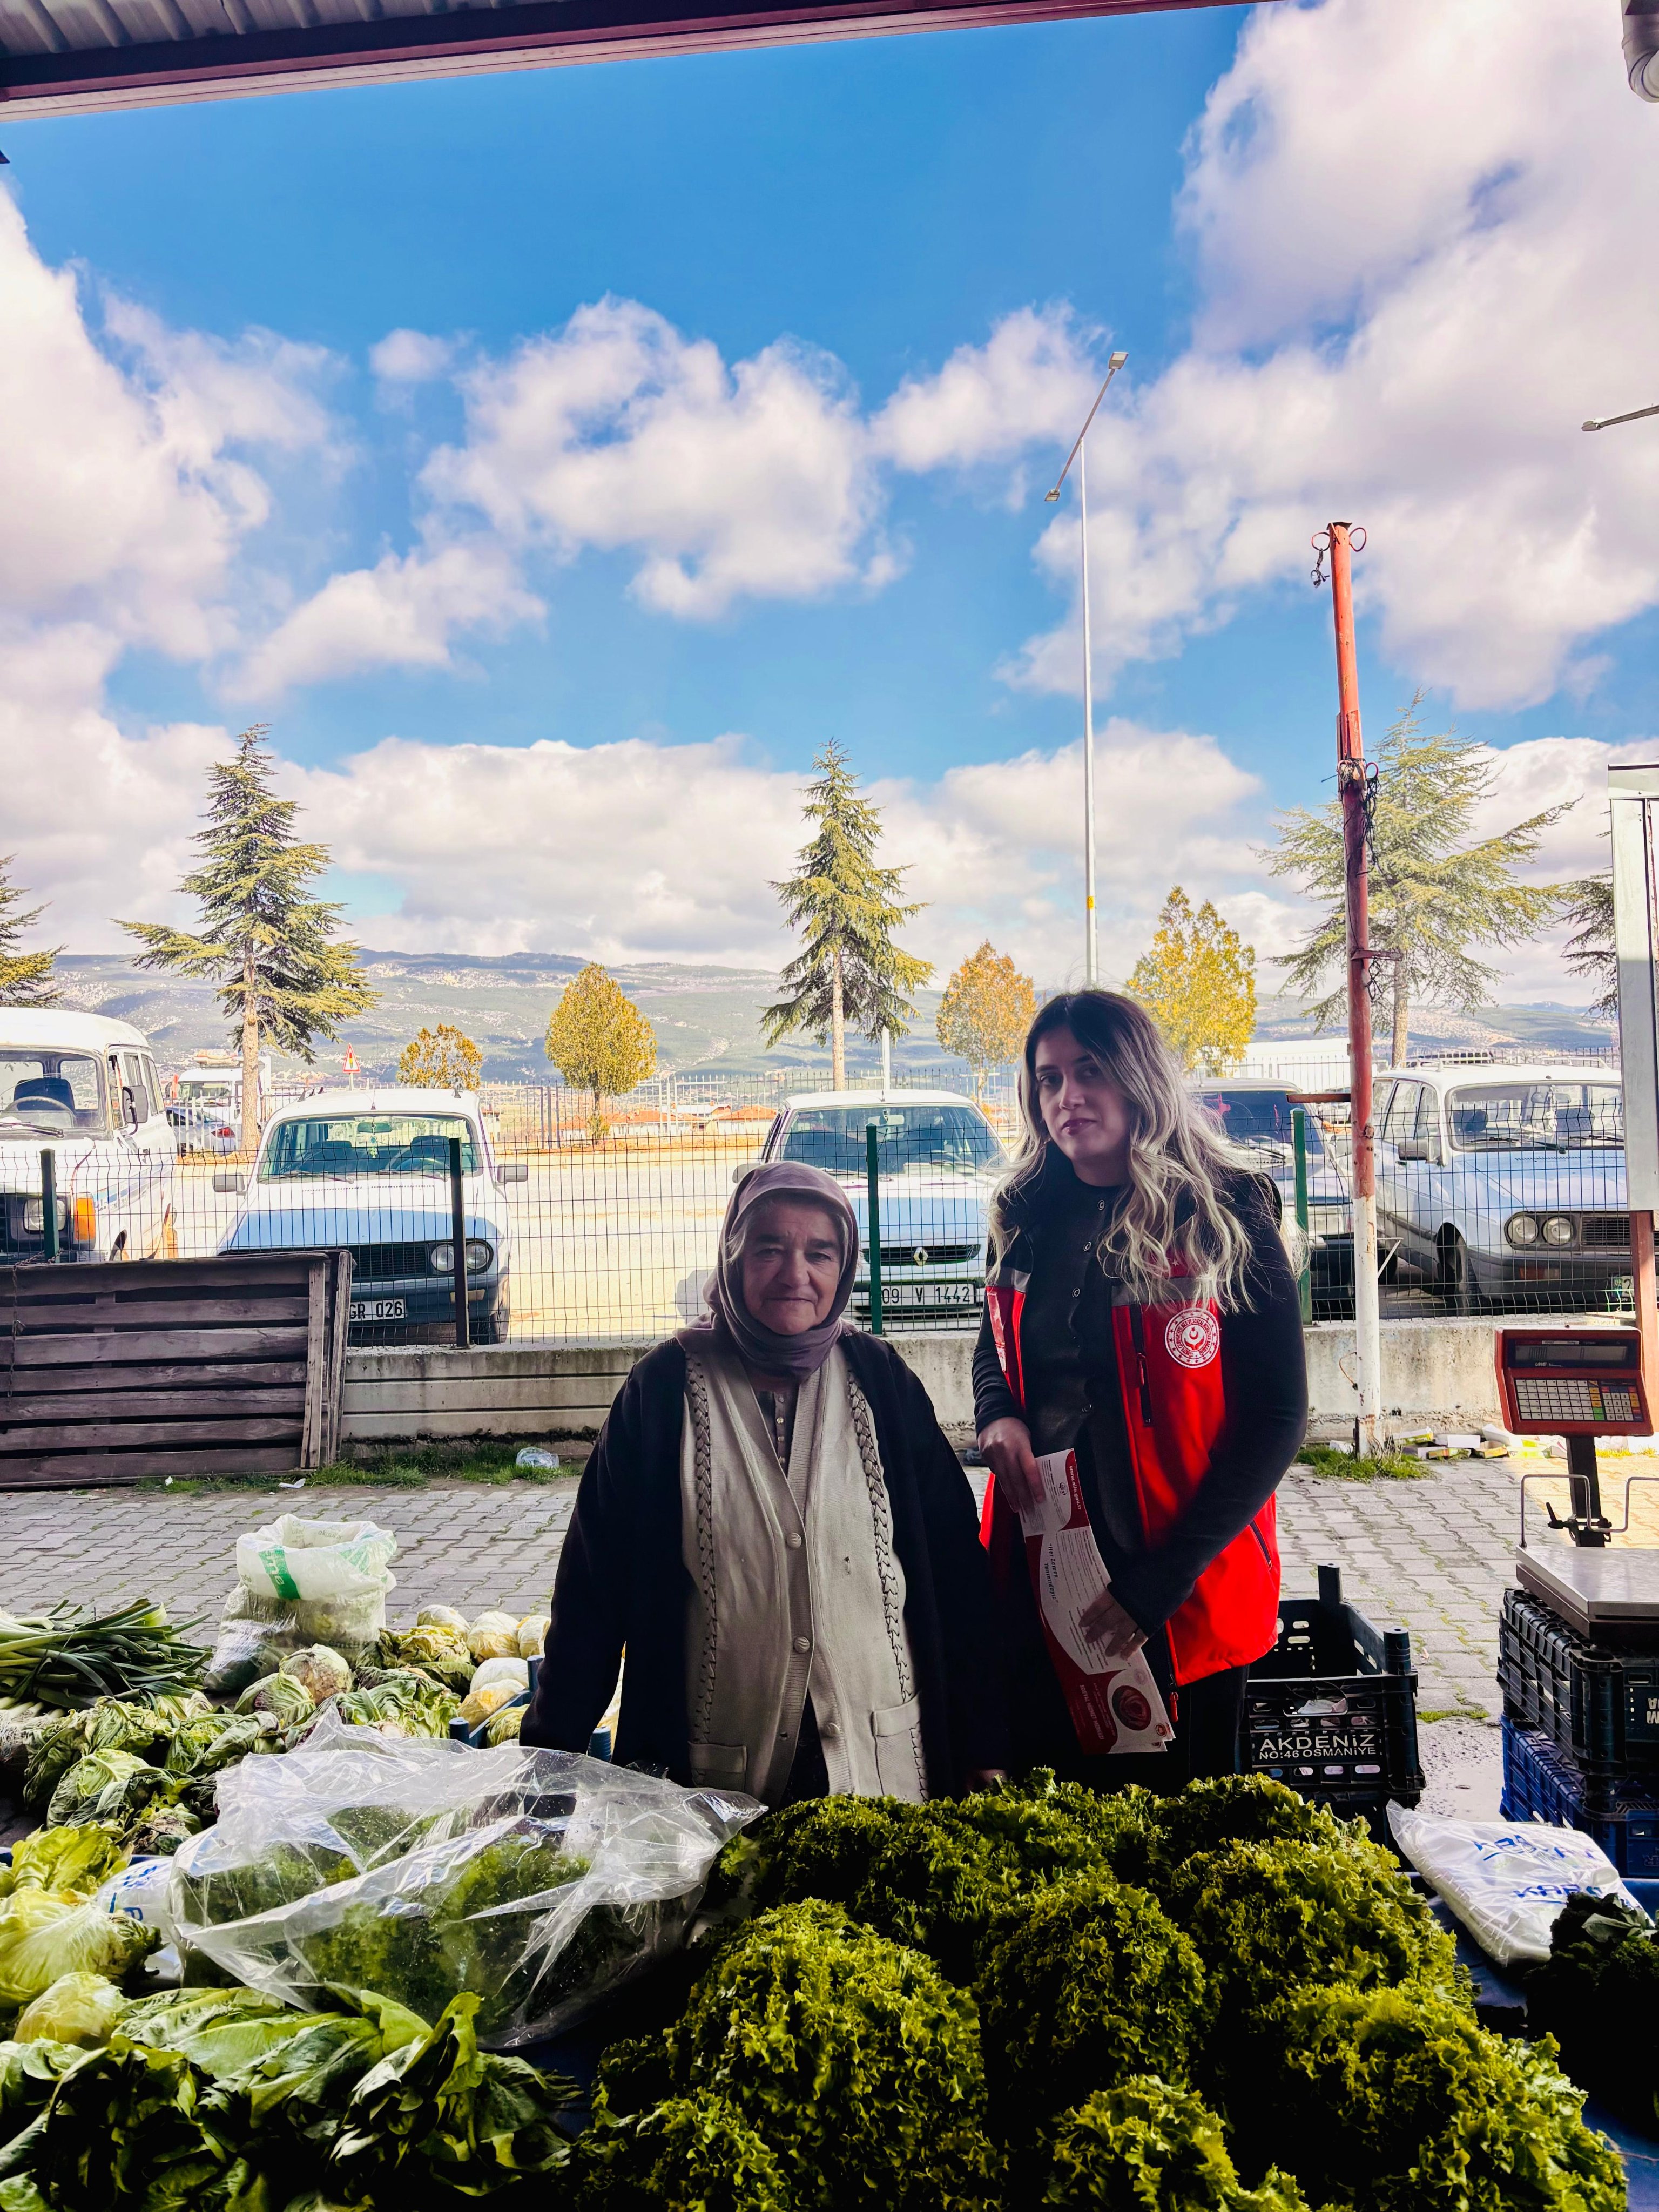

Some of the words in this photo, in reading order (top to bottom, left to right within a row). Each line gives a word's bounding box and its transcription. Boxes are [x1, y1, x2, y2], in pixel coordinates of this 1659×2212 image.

[882, 1288, 899, 1304] 09
[915, 1287, 923, 1303] V
[935, 1286, 970, 1303] 1442
[350, 1303, 366, 1319] GR
[376, 1301, 403, 1318] 026
[1259, 1750, 1299, 1760] NO:46
